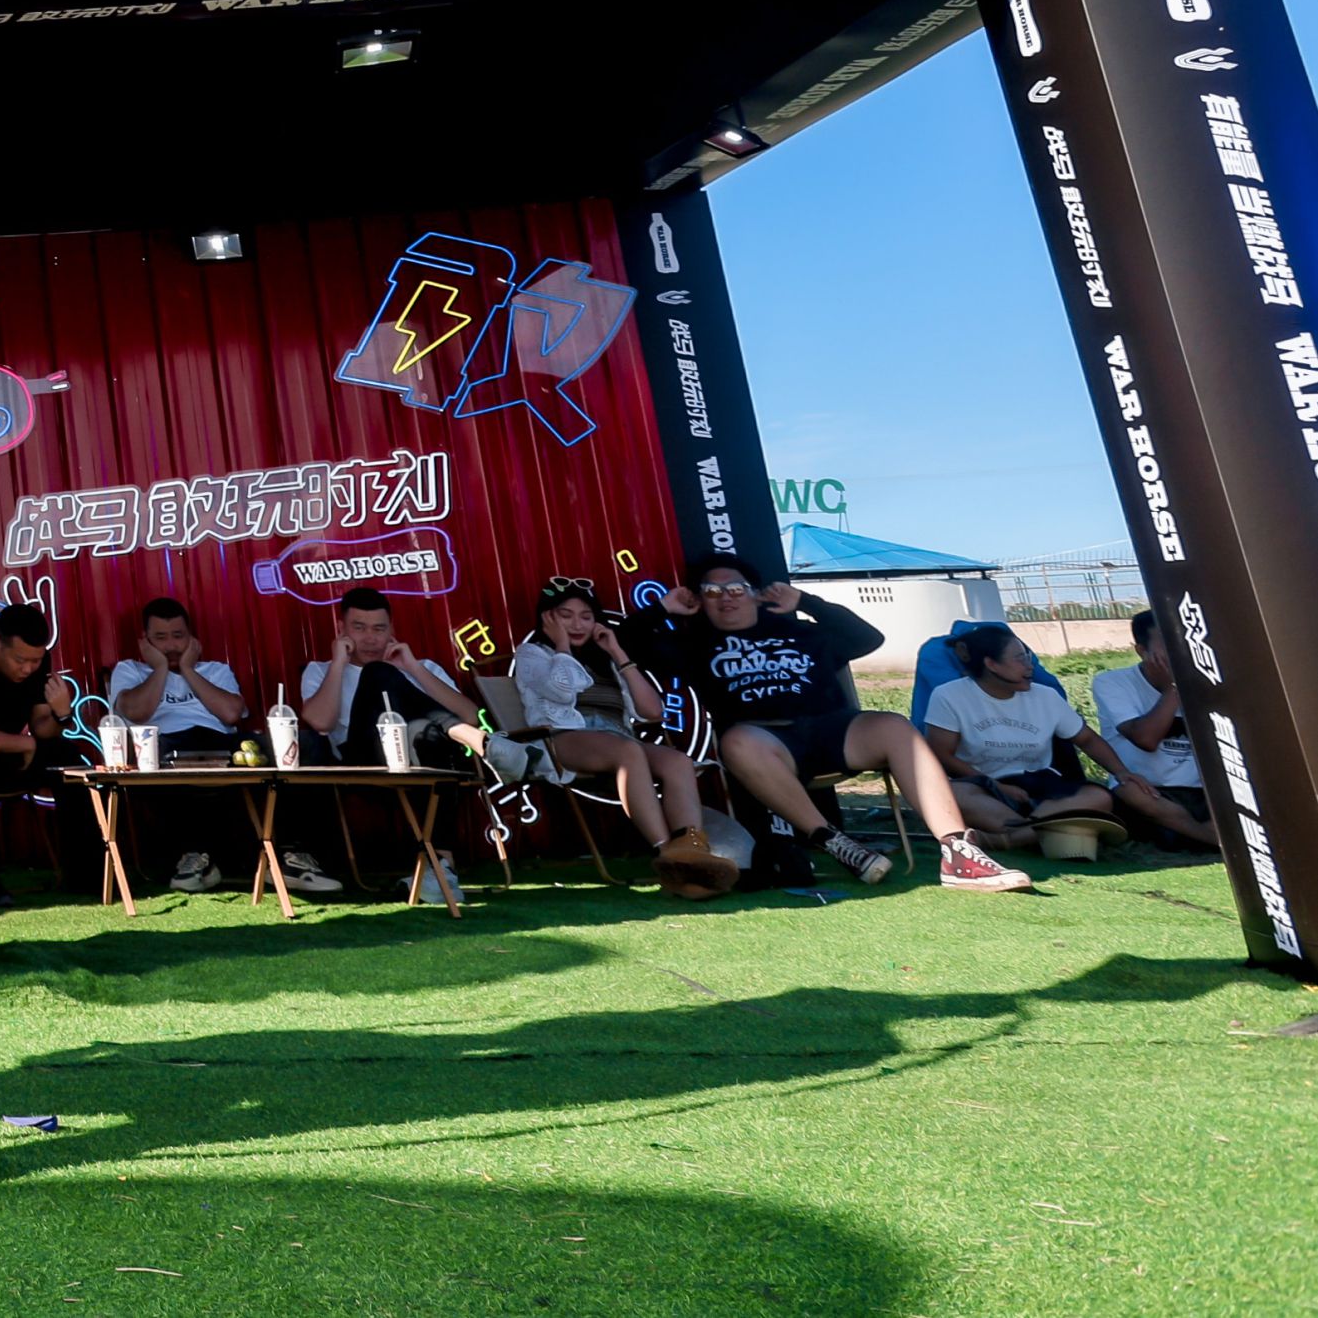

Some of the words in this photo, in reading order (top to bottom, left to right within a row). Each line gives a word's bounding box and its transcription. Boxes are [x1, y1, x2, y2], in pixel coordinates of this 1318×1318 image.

[1199, 92, 1265, 183] 有能量
[1227, 182, 1304, 309] 当燃战马
[1042, 124, 1077, 181] 战马
[1060, 185, 1113, 309] 敢玩时刻
[1102, 334, 1145, 423] WAR
[1125, 424, 1186, 563] HORSE
[3, 484, 140, 569] 战马
[144, 447, 452, 551] 敢玩时刻
[696, 455, 727, 518] WAR
[769, 478, 847, 515] WC
[293, 561, 350, 586] WAR
[349, 548, 441, 581] HORSE
